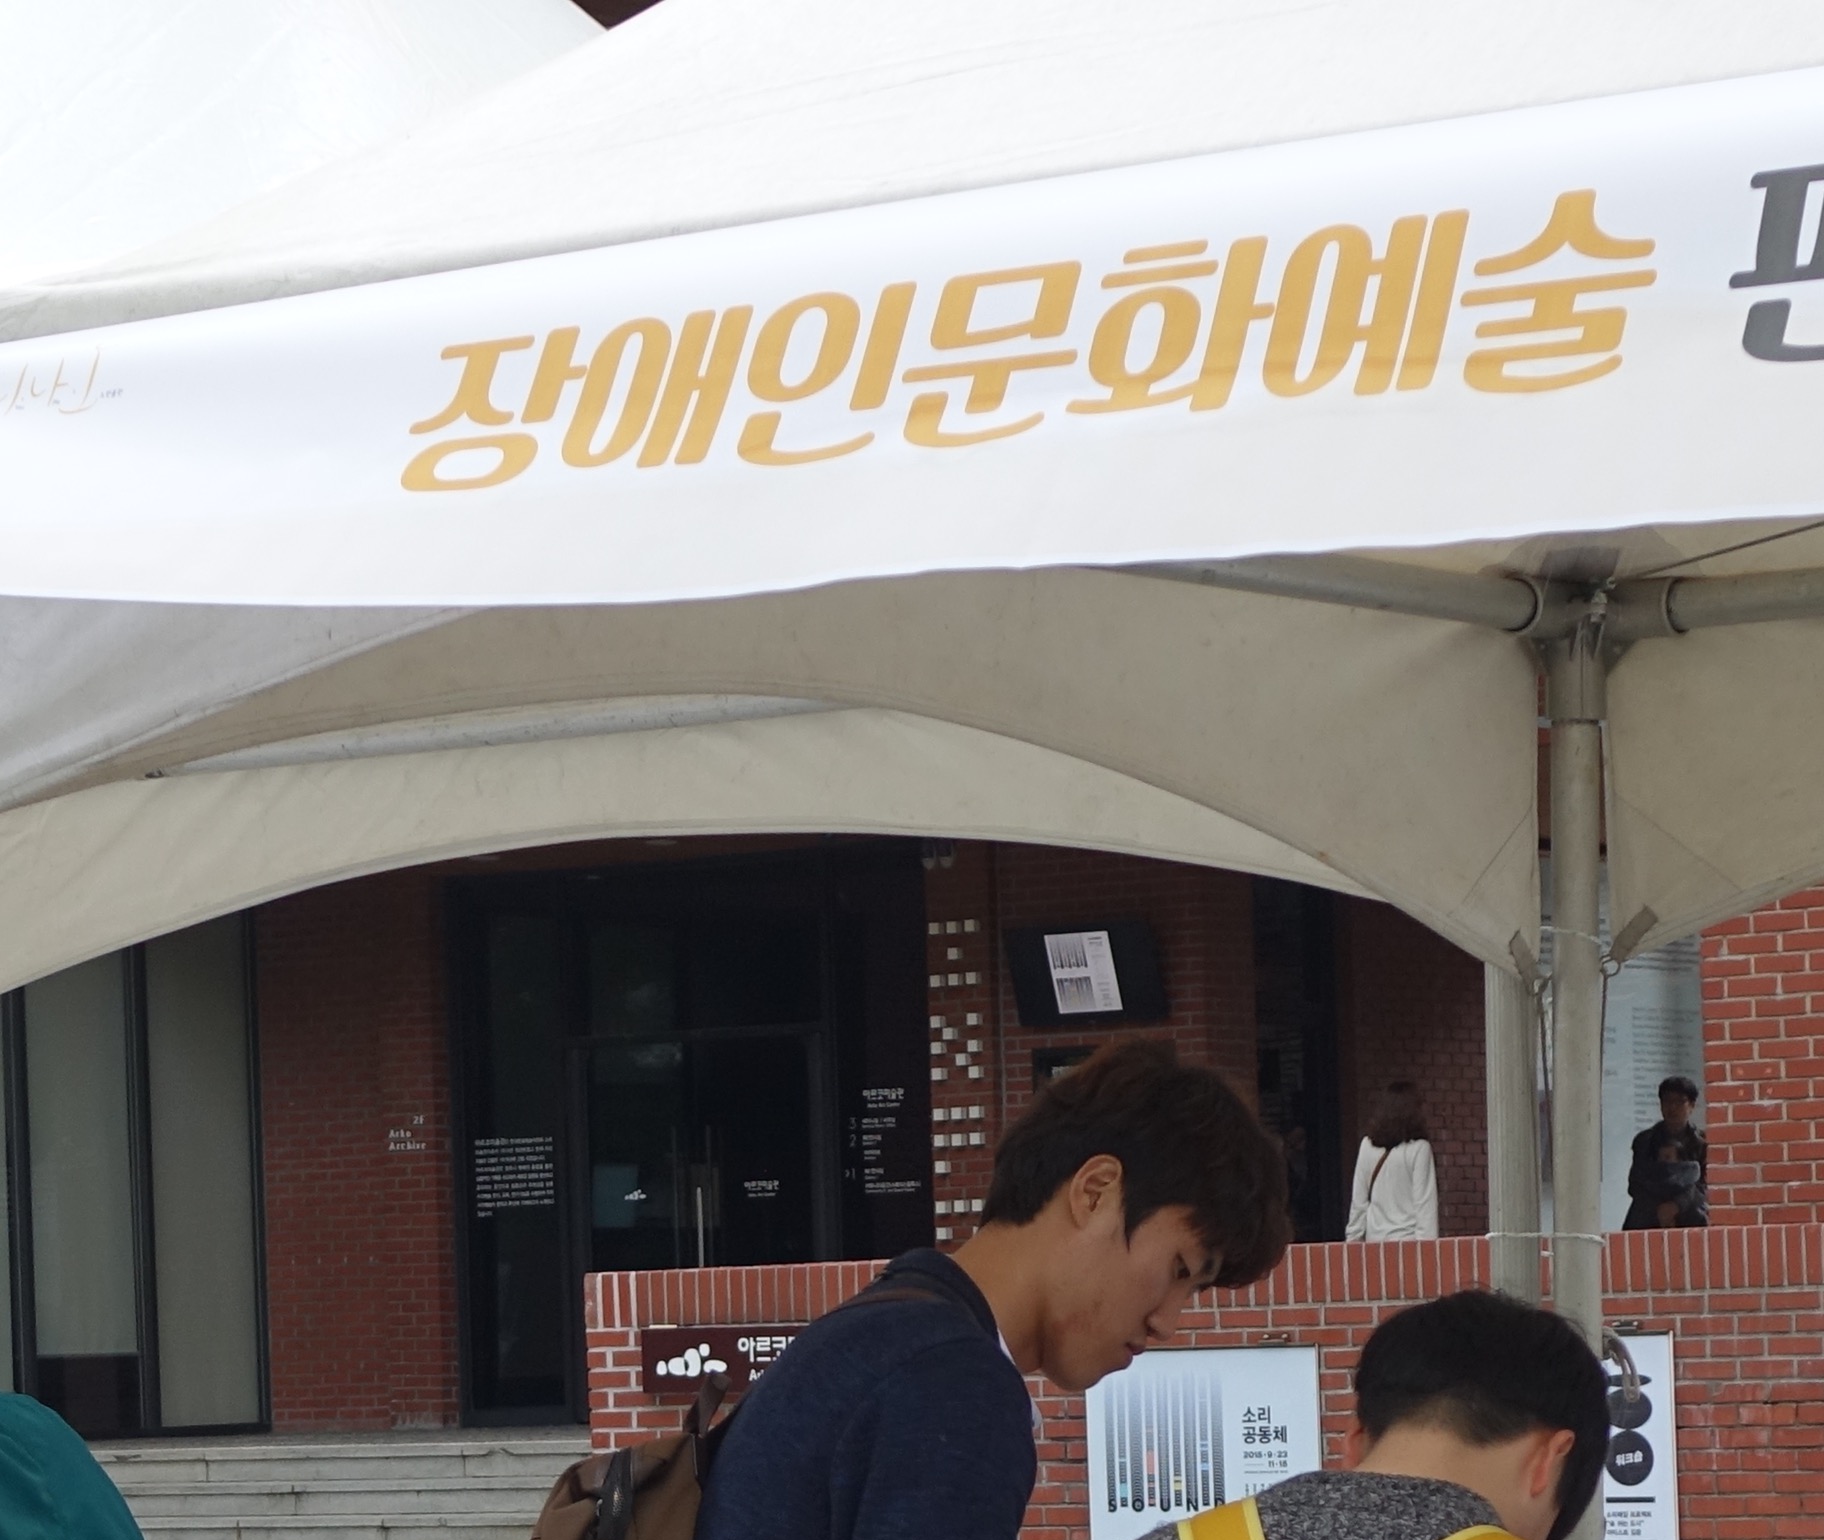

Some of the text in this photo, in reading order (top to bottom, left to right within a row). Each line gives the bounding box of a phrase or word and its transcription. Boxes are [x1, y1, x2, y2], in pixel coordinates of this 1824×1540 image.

[401, 189, 1657, 493] 장애인문화예술
[737, 1336, 796, 1363] 아르코
[1242, 1405, 1271, 1424] 소리
[1242, 1425, 1287, 1444] 공동체
